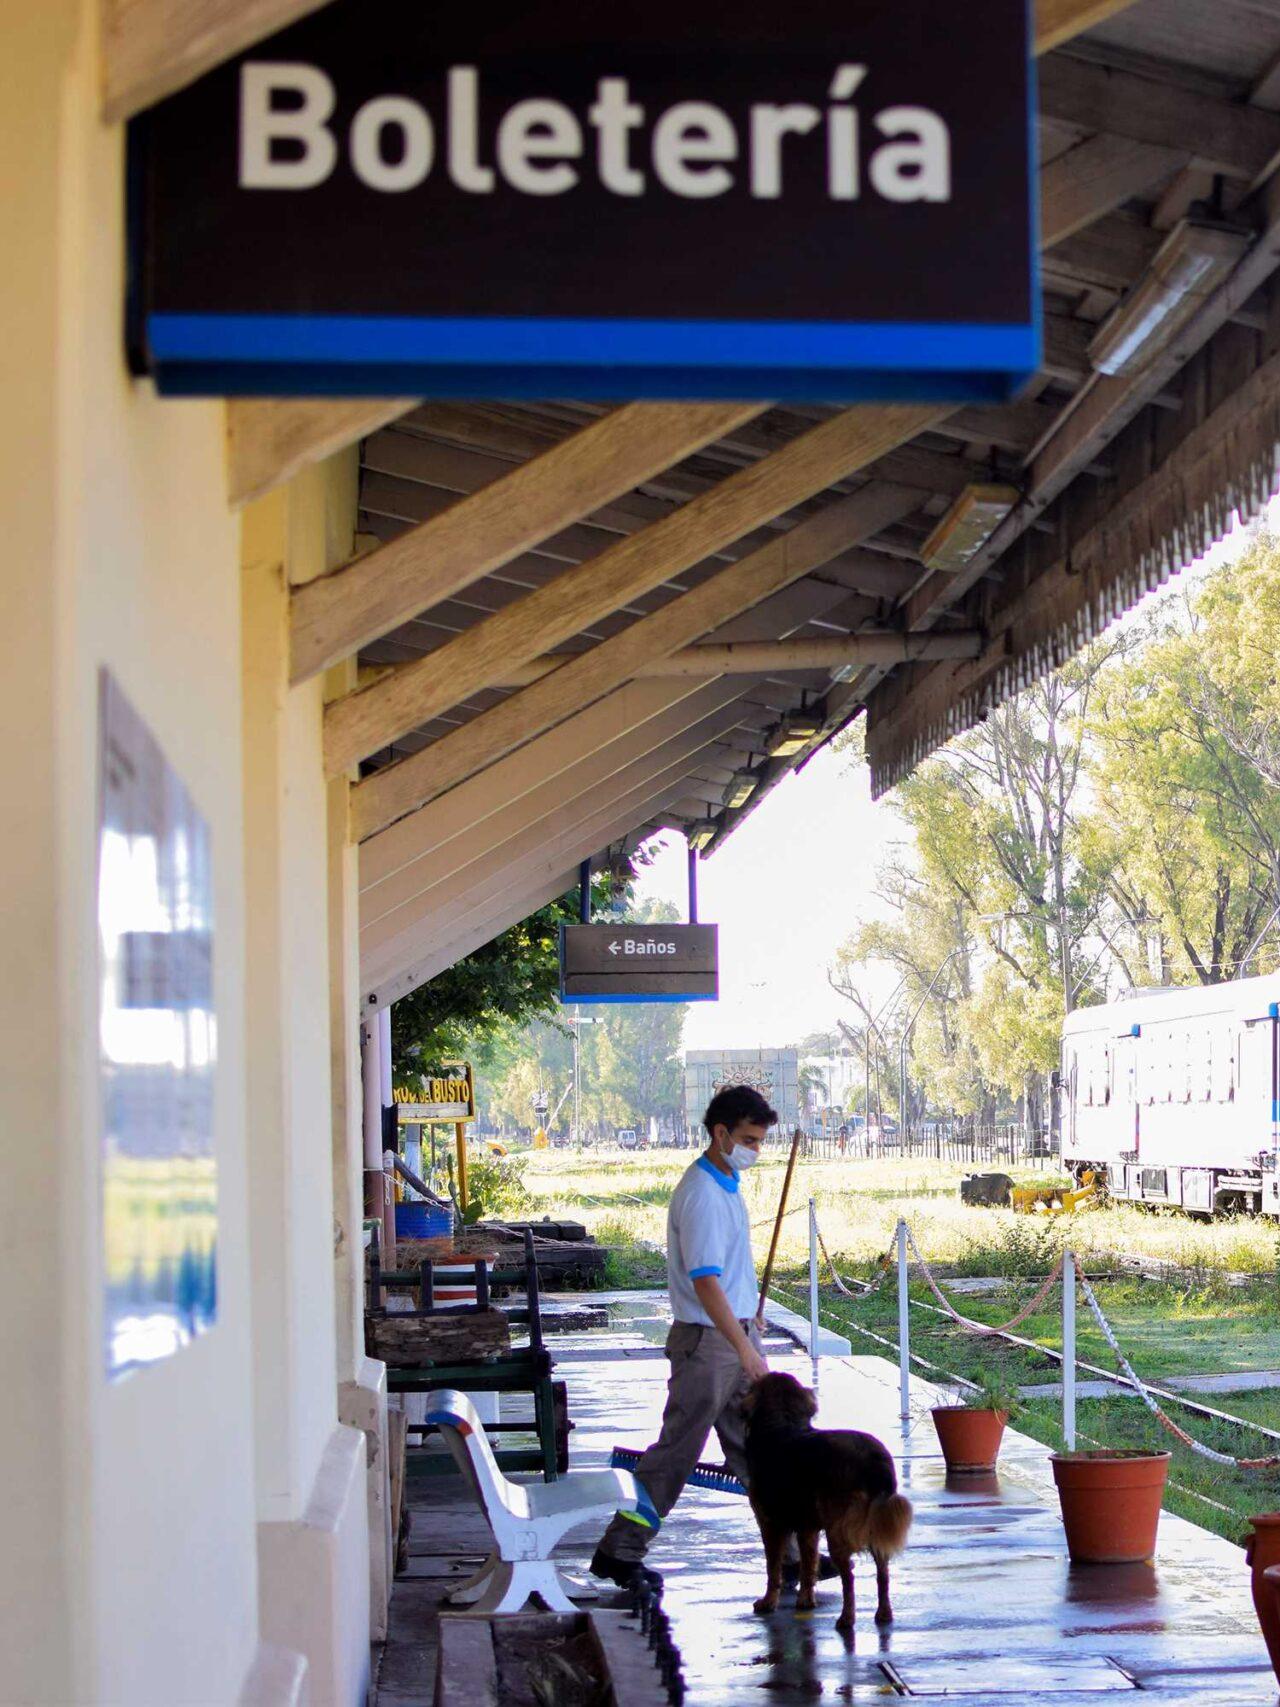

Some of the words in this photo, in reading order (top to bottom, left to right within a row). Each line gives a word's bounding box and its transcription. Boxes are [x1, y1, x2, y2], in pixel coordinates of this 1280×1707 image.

[238, 61, 951, 202] Boletería
[624, 938, 677, 955] Baños
[432, 1077, 470, 1103] BUSTO
